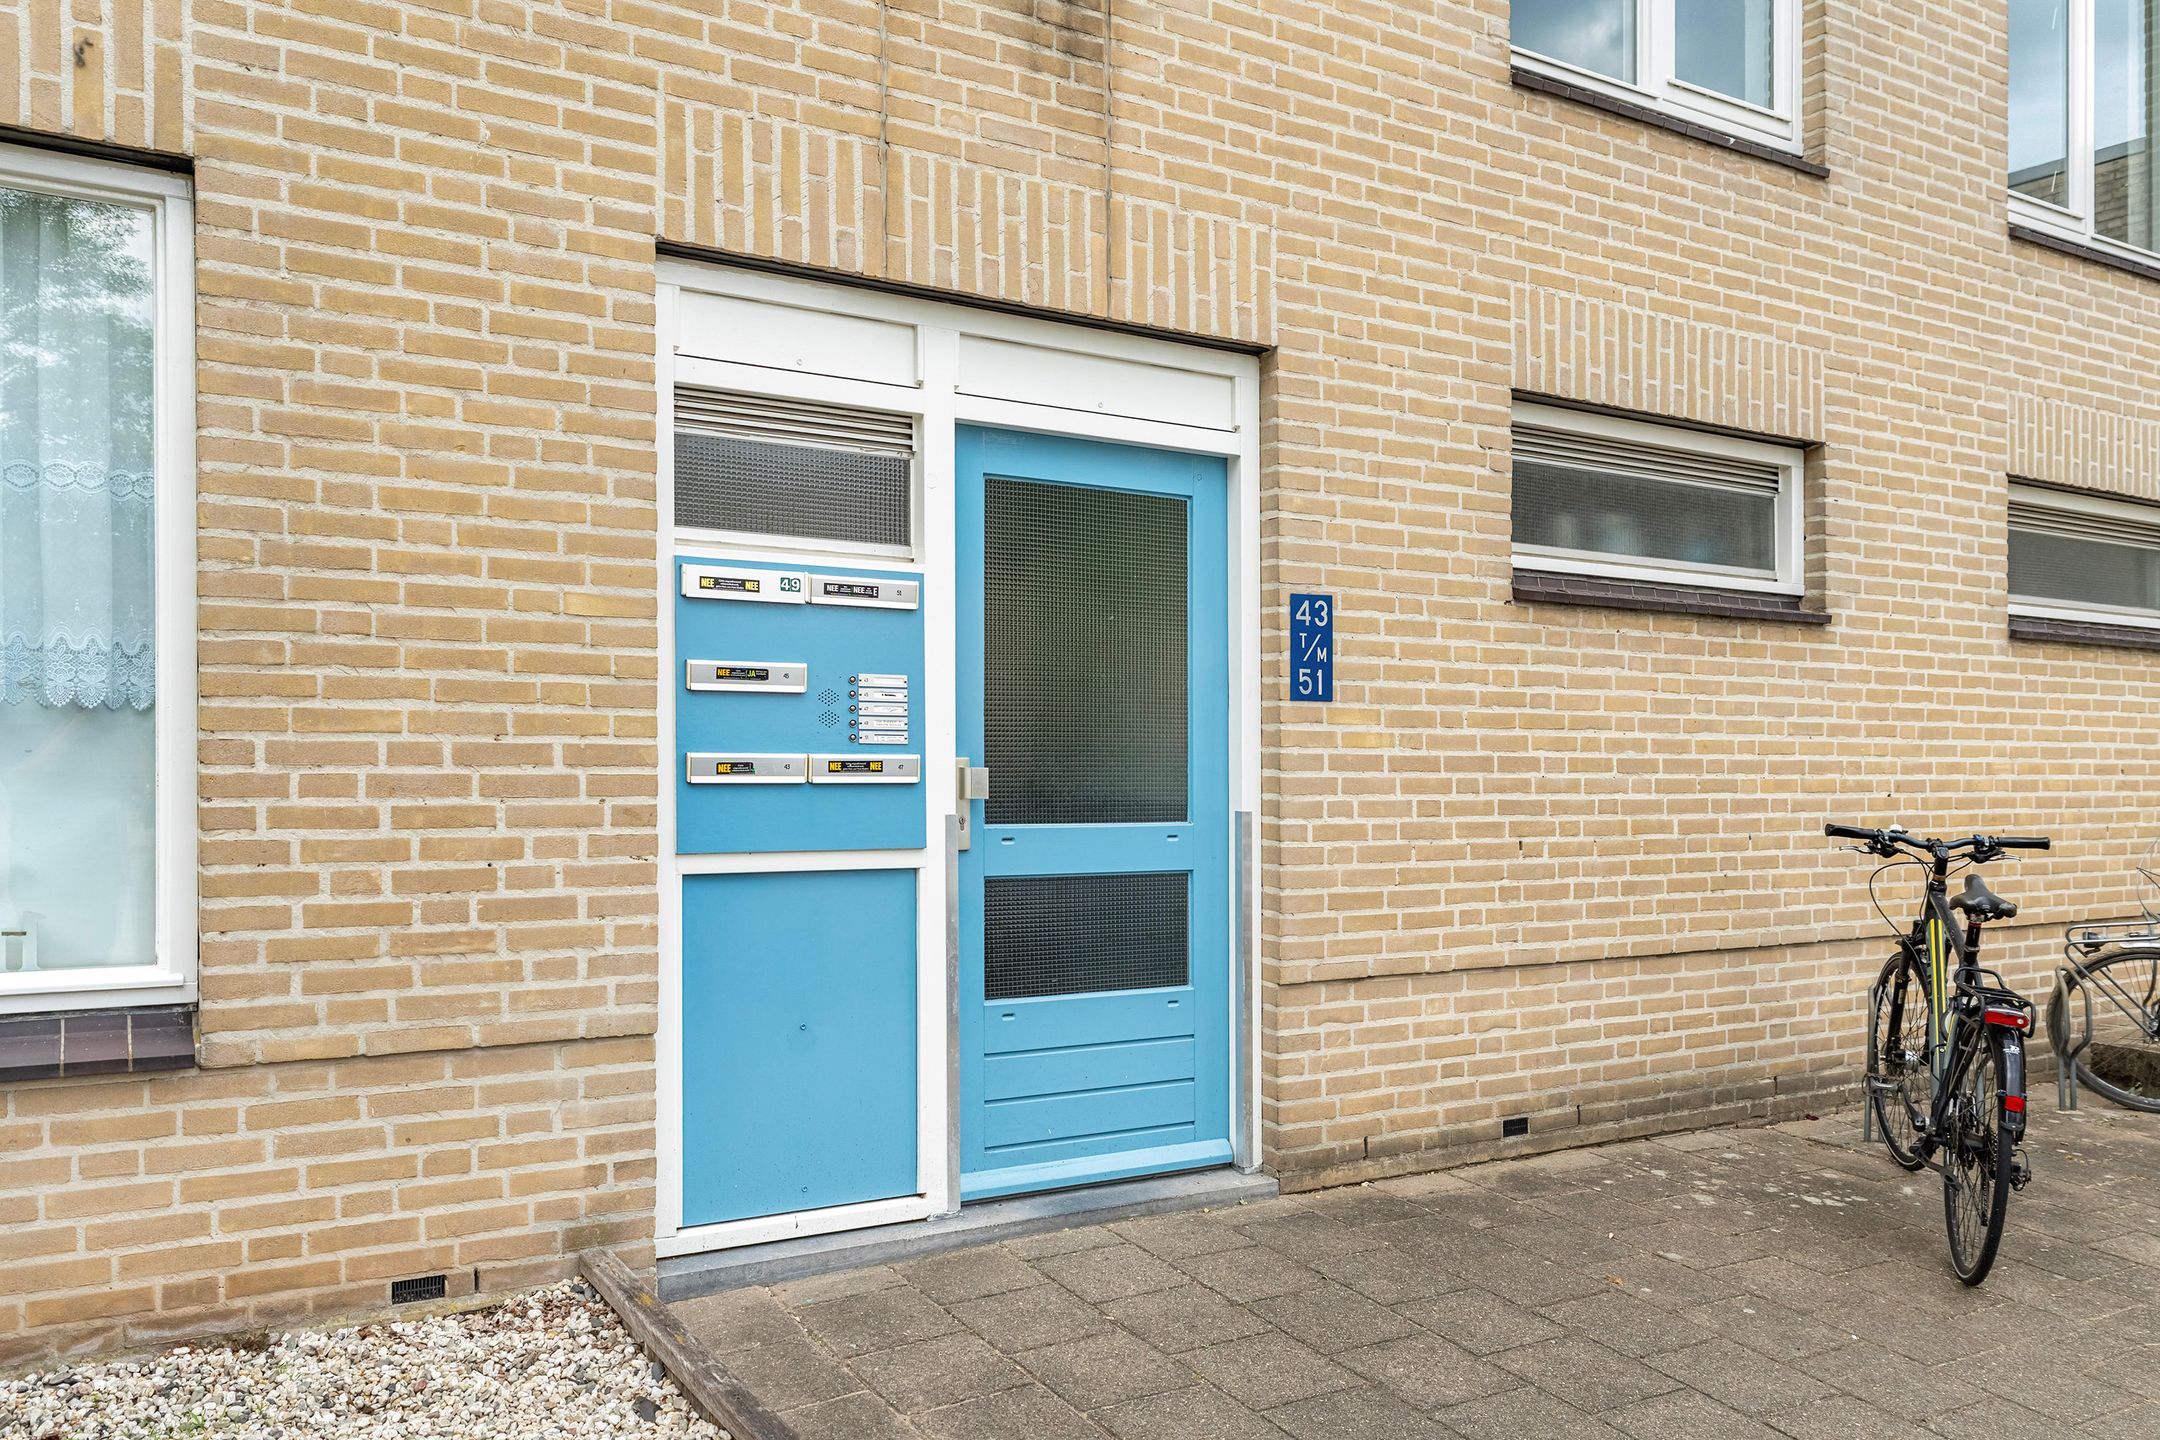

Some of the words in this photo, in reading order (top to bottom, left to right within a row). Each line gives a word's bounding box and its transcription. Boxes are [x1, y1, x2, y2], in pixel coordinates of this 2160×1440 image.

[701, 578, 715, 588] NEE
[745, 581, 759, 591] NEE
[781, 578, 800, 592] 49
[826, 584, 839, 592] NEE
[853, 586, 865, 594] NEE
[1296, 599, 1328, 627] 43
[1299, 633, 1327, 663] T/M
[717, 669, 731, 677] NEE
[1299, 668, 1323, 695] 51
[718, 764, 731, 773] NEE
[829, 762, 842, 771] NEE
[869, 762, 882, 771] NEE
